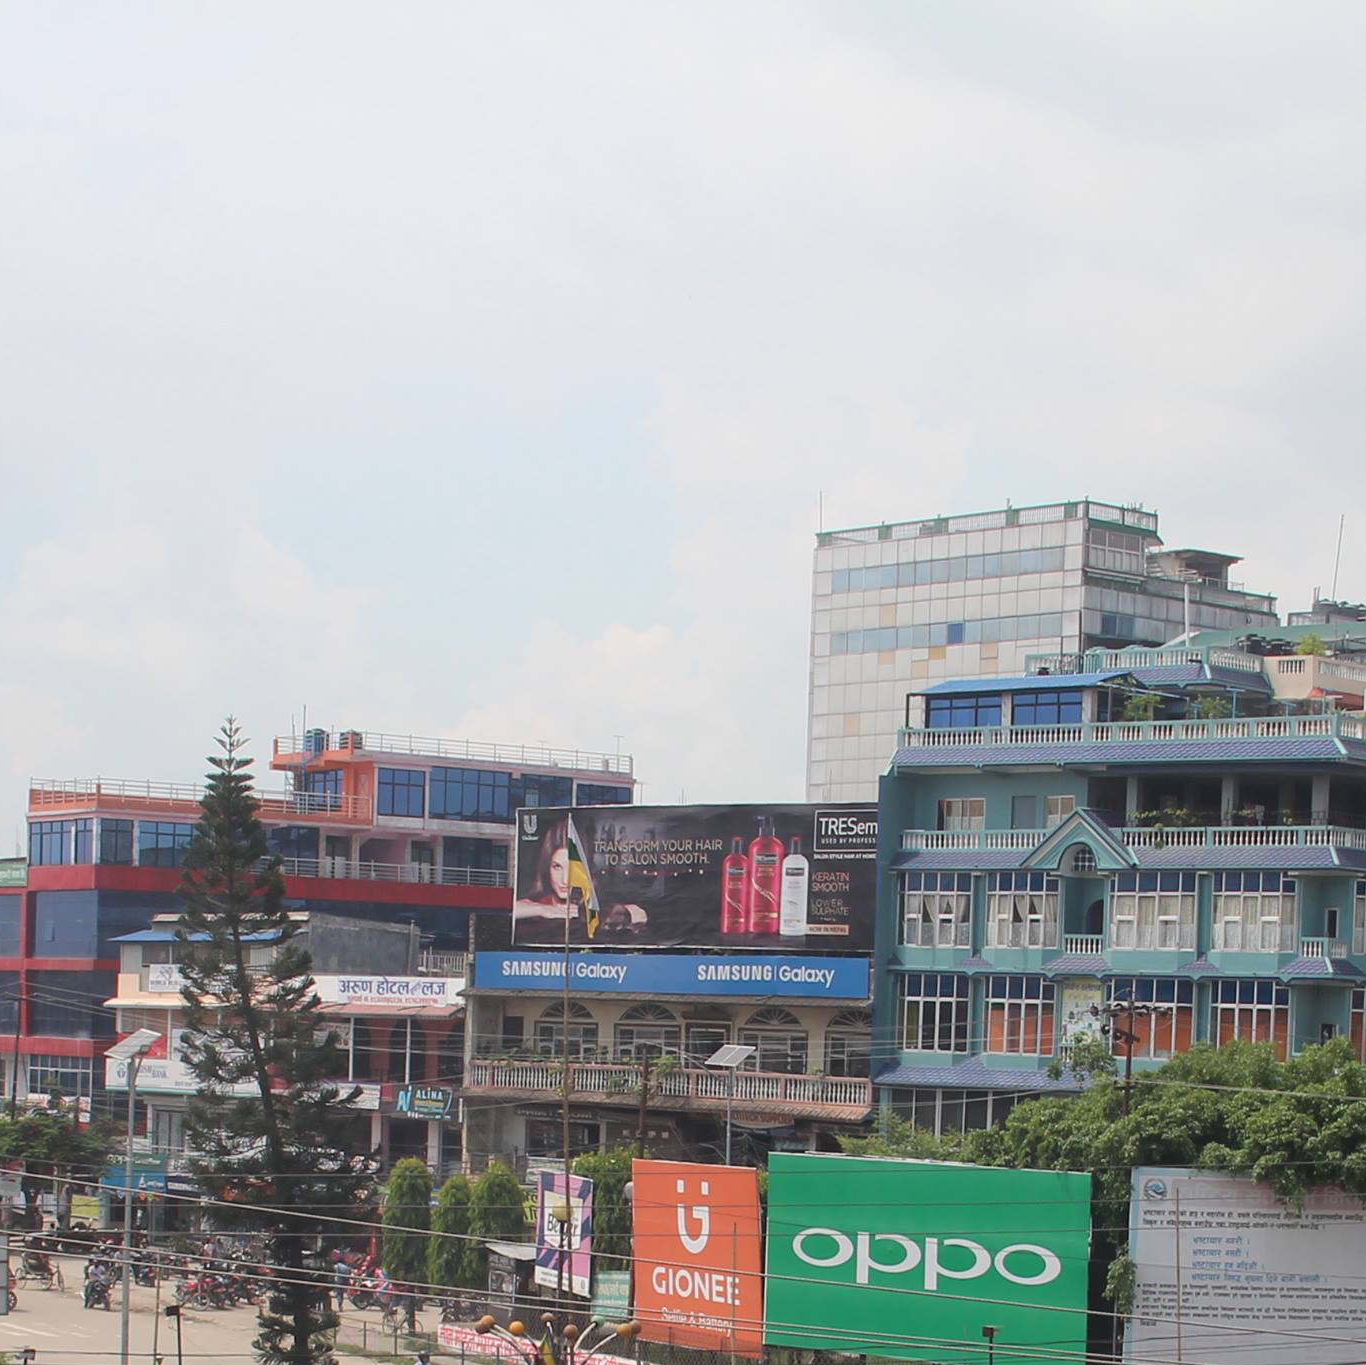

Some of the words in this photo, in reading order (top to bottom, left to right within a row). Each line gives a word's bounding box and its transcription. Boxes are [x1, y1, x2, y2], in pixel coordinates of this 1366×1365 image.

[594, 841, 659, 852] TRANSFORM
[662, 840, 692, 851] YOUR
[695, 839, 722, 850] HAIR
[604, 854, 618, 865] TO
[621, 854, 658, 865] SALON
[660, 853, 710, 864] SMOOTH.
[812, 872, 849, 881] KERATIN
[812, 883, 849, 892] SMOOTH
[812, 899, 843, 907] LOWER
[502, 960, 570, 976] SAMSUNG
[576, 962, 627, 983] Galaxy
[697, 964, 772, 981] SAMSUNG
[779, 965, 835, 988] Galaxy
[339, 980, 373, 994] अरुण
[376, 976, 410, 995] होटल
[421, 981, 446, 995] लज
[792, 1227, 1062, 1291] oppo
[652, 1266, 740, 1305] GIONEE
[688, 1311, 696, 1322] &
